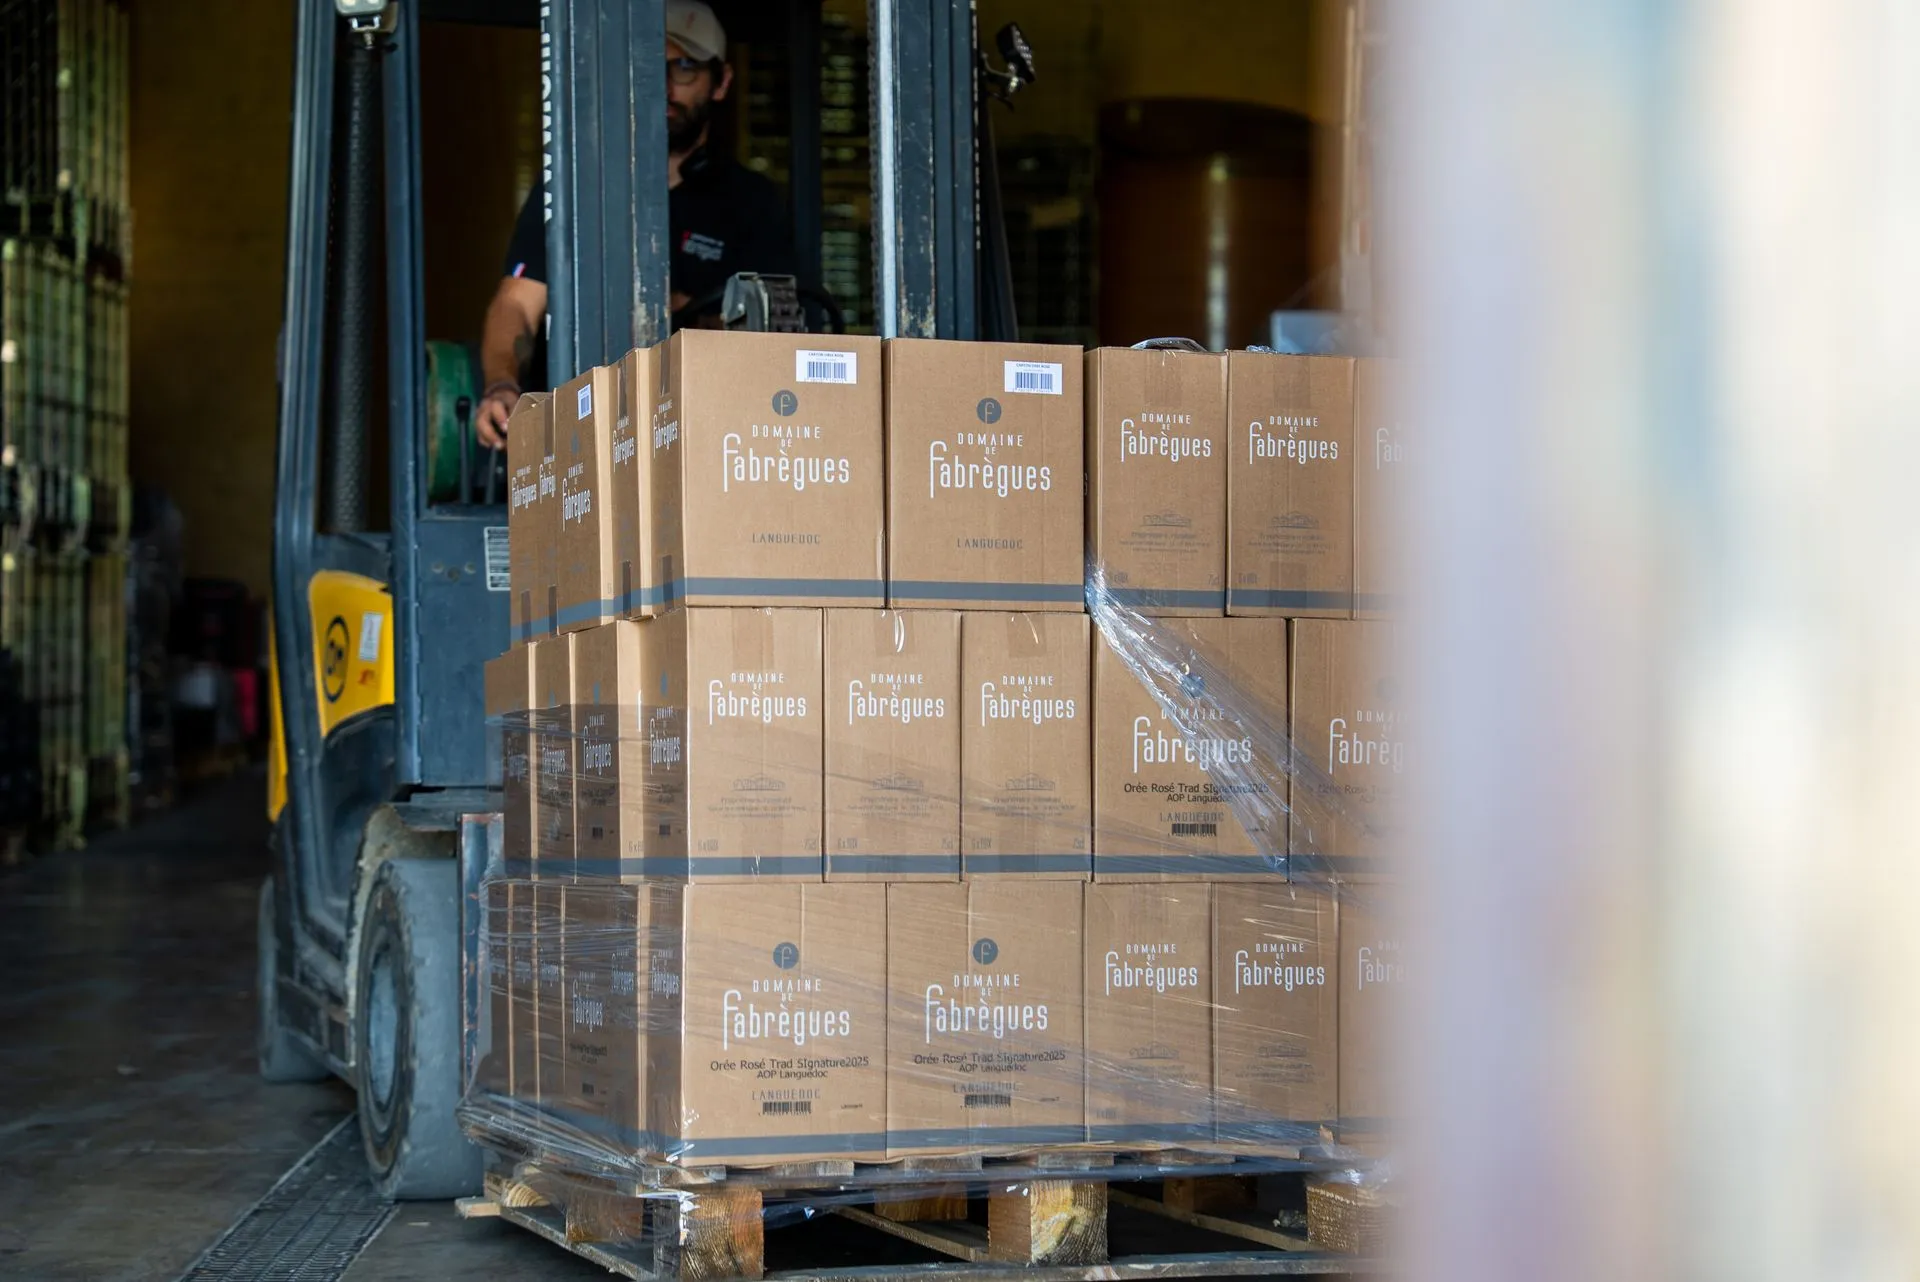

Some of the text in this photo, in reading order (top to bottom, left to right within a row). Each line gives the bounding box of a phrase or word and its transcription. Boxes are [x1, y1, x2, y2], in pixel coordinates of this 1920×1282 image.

[1142, 412, 1192, 425] DOMAINE
[1270, 416, 1319, 428] DOMAINE
[752, 424, 820, 440] DOMAINE
[781, 439, 792, 448] DE
[957, 432, 1024, 448] DOMAINE
[985, 446, 996, 455] DE
[752, 532, 821, 545] LANGUEDOC
[957, 538, 1024, 550] LANGUEDOC
[731, 672, 784, 684] DOMAINE
[871, 674, 924, 685] DOMAINE
[1002, 675, 1054, 687] DOMAINE
[1124, 782, 1148, 793] Orée
[1152, 782, 1174, 793] Rosé
[1178, 783, 1200, 793] Trad
[1166, 794, 1184, 802] AOP
[1126, 944, 1177, 954] DOMAINE
[1256, 943, 1304, 954] DOMAINE
[753, 979, 821, 993] DOMAINE
[954, 974, 1020, 988] DOMAINE
[981, 988, 992, 996] DE
[782, 994, 792, 1002] DE
[914, 1054, 939, 1064] Orée
[943, 1053, 966, 1064] Rosé
[972, 1052, 993, 1063] Trad
[710, 1060, 736, 1071] Orée
[740, 1058, 766, 1070] Rosé
[770, 1058, 792, 1069] Trad
[960, 1064, 978, 1072] AOP
[757, 1070, 828, 1080] AOP Languedoc
[752, 1089, 820, 1100] LANGUEDOC
